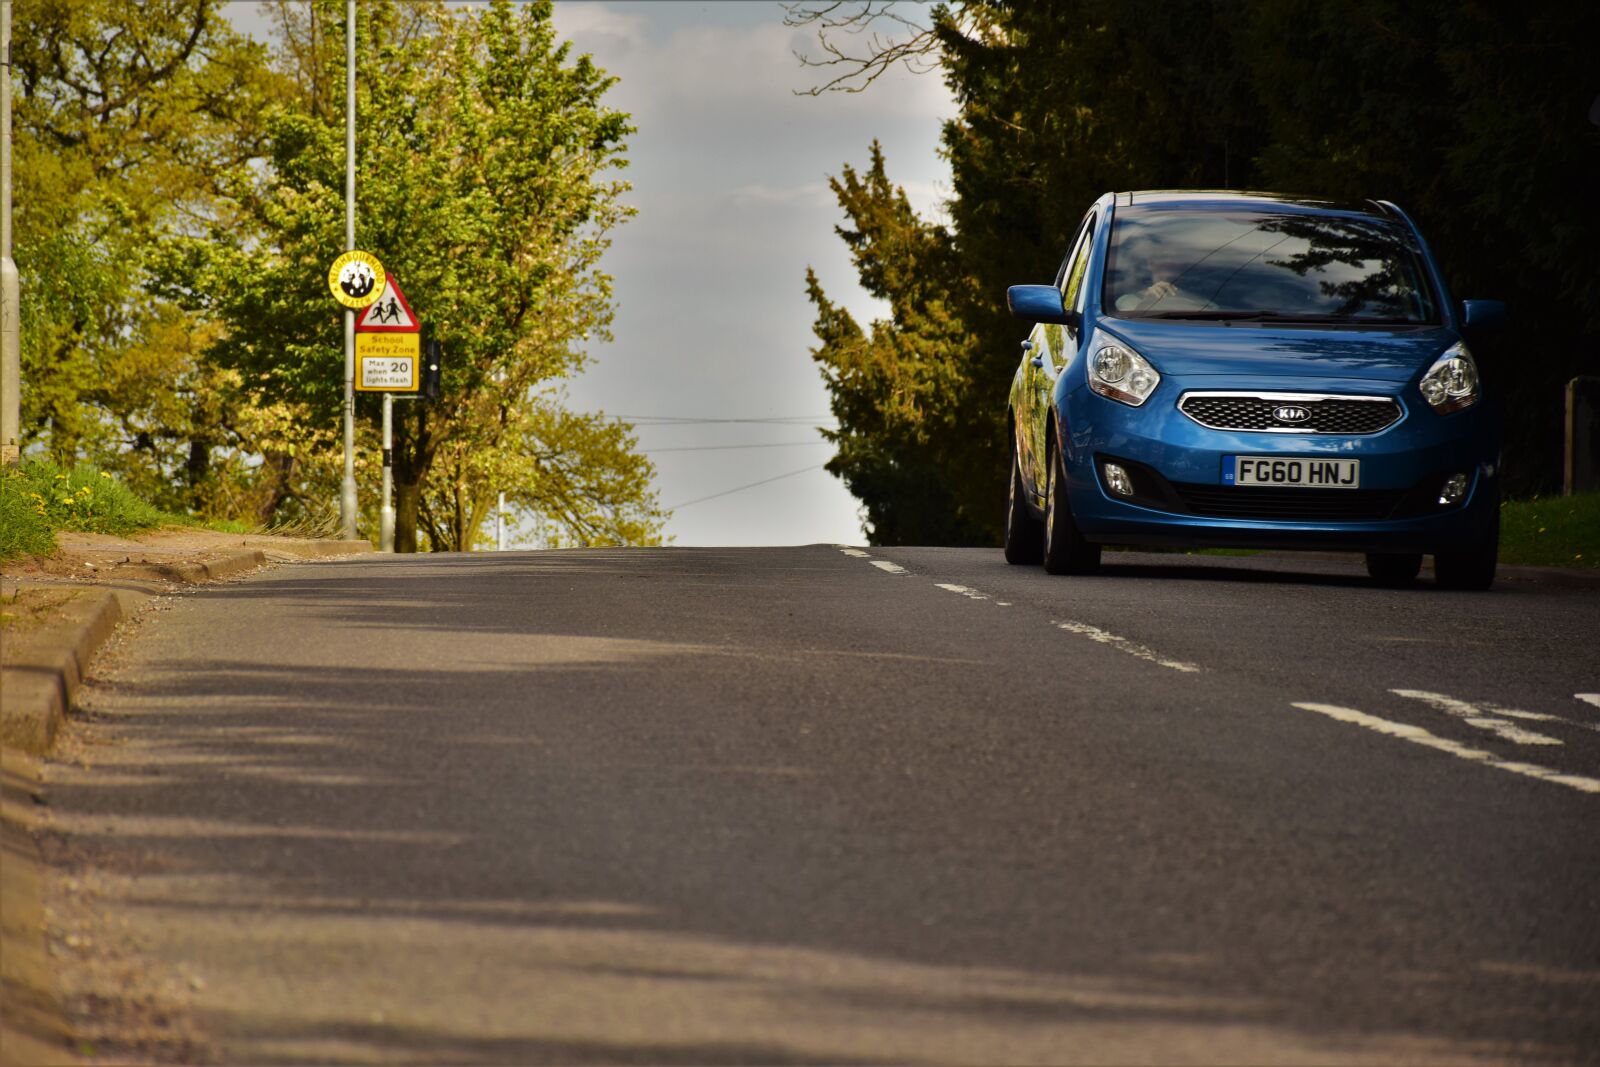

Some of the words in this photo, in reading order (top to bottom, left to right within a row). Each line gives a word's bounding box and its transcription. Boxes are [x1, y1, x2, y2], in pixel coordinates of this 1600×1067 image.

[330, 251, 385, 284] NEIGHBOURHOOD
[343, 296, 371, 307] WATCH
[371, 335, 404, 344] School
[360, 345, 390, 354] Safety
[393, 345, 416, 353] Zone
[391, 362, 408, 373] 20
[1279, 408, 1305, 419] KIA
[1239, 460, 1302, 483] FG60
[1308, 462, 1355, 485] HNJ
